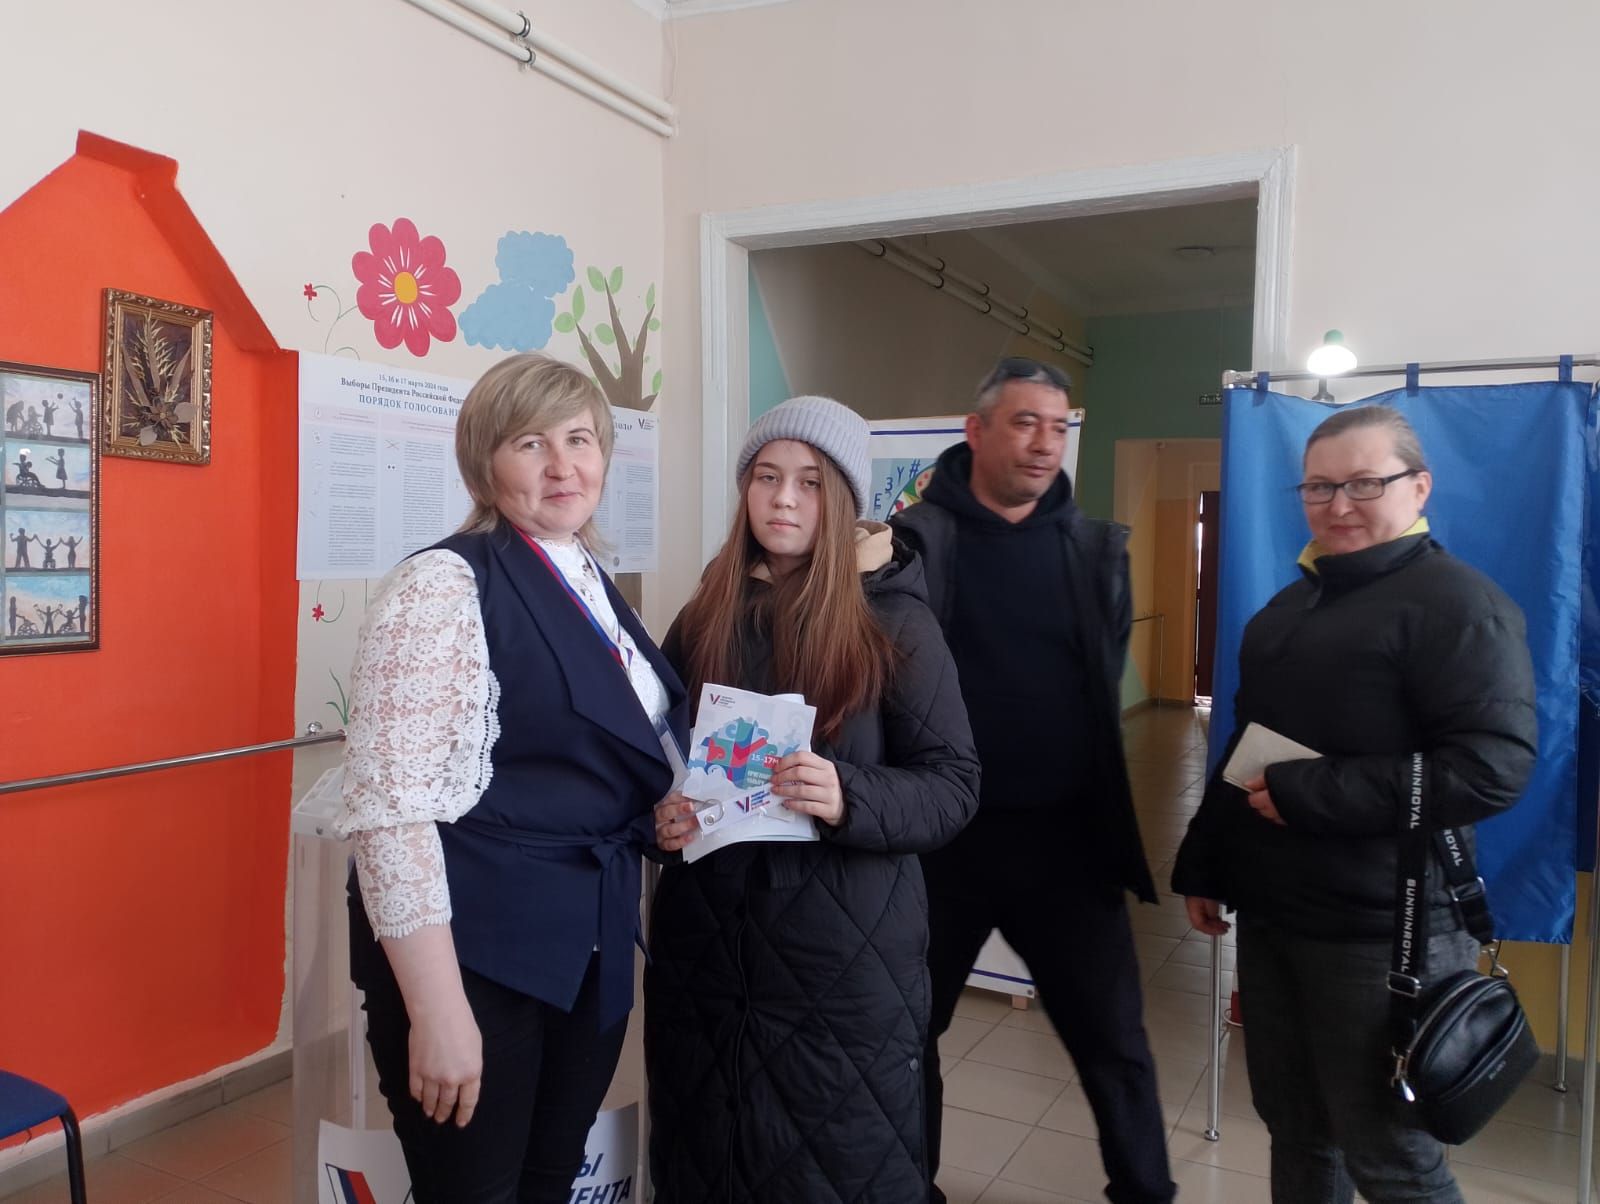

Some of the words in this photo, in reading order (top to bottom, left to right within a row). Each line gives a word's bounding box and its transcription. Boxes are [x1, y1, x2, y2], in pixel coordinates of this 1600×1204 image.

[341, 377, 370, 390] Выборы
[371, 382, 411, 396] Президента
[359, 394, 401, 409] ПОРЯДОК
[1410, 752, 1423, 829] UNWINROYAL
